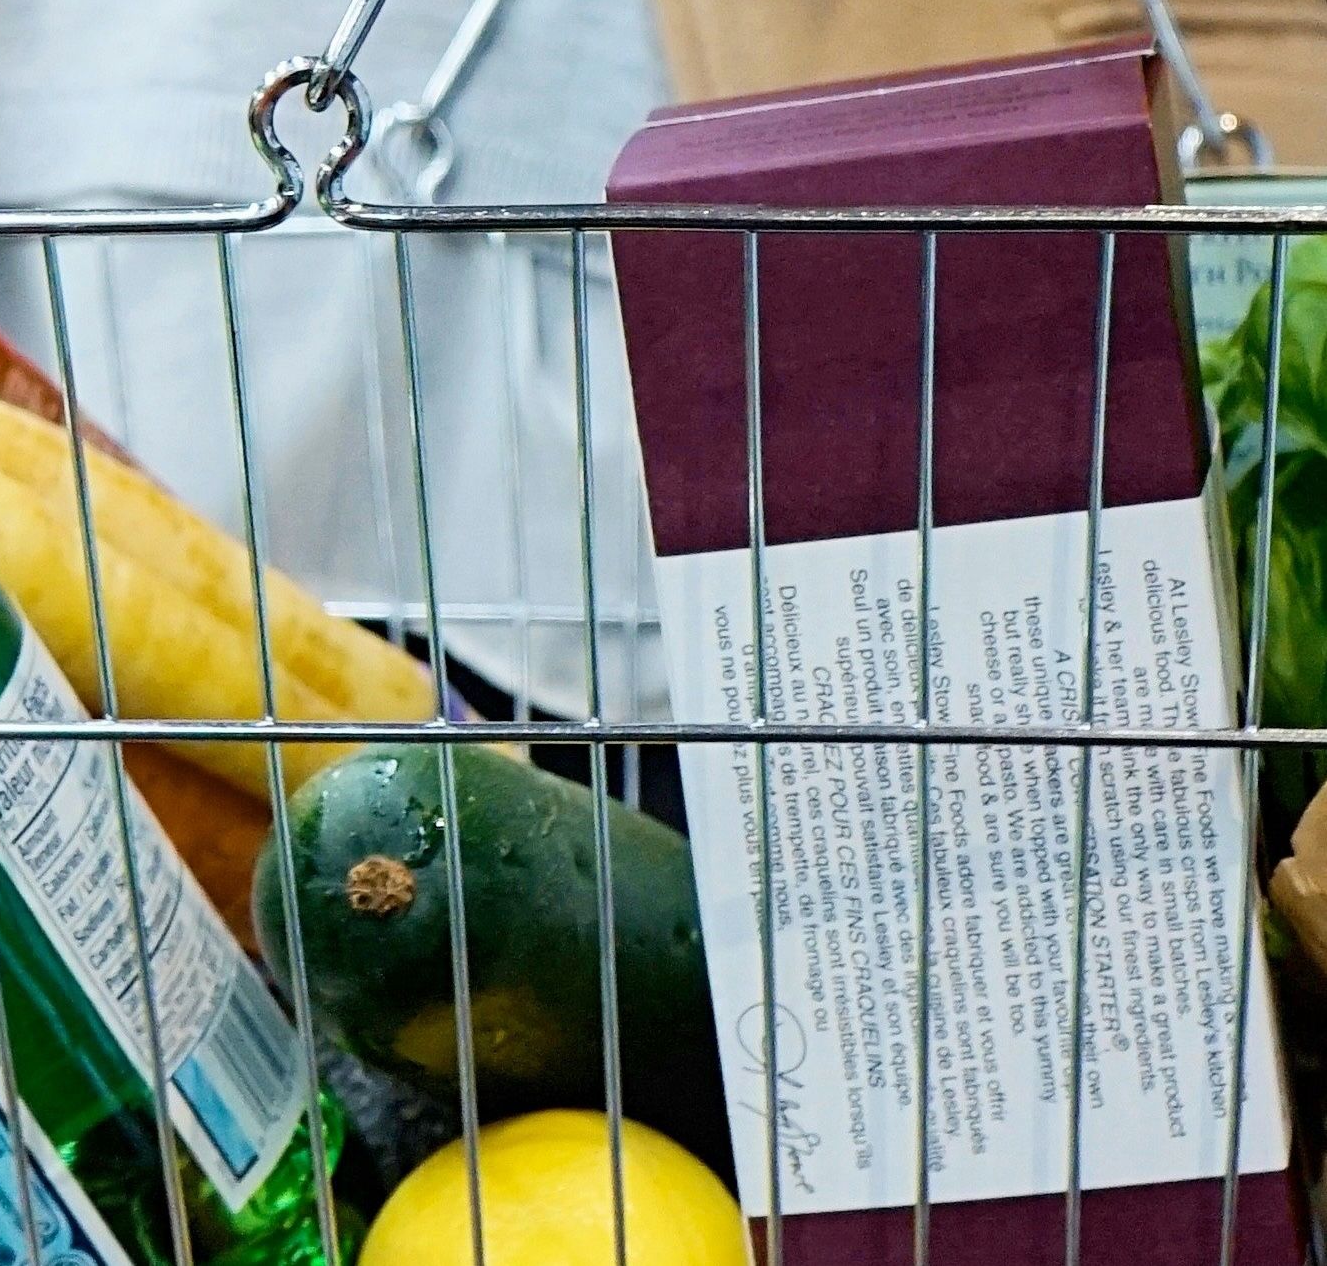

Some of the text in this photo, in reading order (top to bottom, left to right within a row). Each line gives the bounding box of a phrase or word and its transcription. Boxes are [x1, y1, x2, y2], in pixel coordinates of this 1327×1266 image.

[850, 568, 870, 611] Seul
[897, 578, 915, 603] de
[1169, 577, 1186, 597] At
[714, 606, 730, 649] vous
[779, 585, 805, 671] Délicieux
[857, 618, 870, 642] un
[876, 597, 892, 643] avec
[1004, 610, 1022, 639] but
[1024, 596, 1045, 649] these
[1105, 619, 1122, 632] &
[1168, 605, 1195, 667] Lesley
[721, 657, 735, 680] ne
[878, 648, 903, 694] soin,
[1004, 646, 1029, 696] really
[1056, 648, 1072, 663] A
[1108, 640, 1126, 670] her
[792, 678, 805, 702] au
[856, 648, 884, 714] produit
[933, 675, 954, 722] Stow
[1028, 656, 1055, 721] unique
[1113, 678, 1134, 726] team
[890, 700, 903, 723] en
[732, 764, 756, 804] plus
[781, 762, 798, 786] de
[847, 744, 875, 813] pouvait
[1024, 760, 1045, 811] when
[1100, 761, 1123, 830] scratch
[806, 786, 821, 819] ces
[949, 789, 970, 847] Foods
[982, 792, 998, 805] &
[1127, 786, 1145, 815] the
[1197, 789, 1219, 848] Foods
[743, 811, 759, 855] vous
[780, 792, 812, 888] trempette,
[876, 795, 905, 874] fabriqué
[985, 814, 999, 843] are
[1053, 814, 1068, 844] are
[1127, 822, 1151, 861] only
[1133, 666, 1193, 1017] are with care in small batches.
[1143, 559, 1230, 1119] delicious food. The fabulous crisps from Lesley's kitchen
[862, 819, 887, 904] satisfaire
[932, 831, 956, 909] fabuleux
[980, 610, 1056, 1104] cheese or We are addicted to this yummy
[990, 850, 1005, 891] sure
[1027, 818, 1054, 883] topped
[1105, 836, 1131, 887] using
[1205, 855, 1219, 882] we
[807, 824, 839, 922] craquelins
[957, 854, 979, 908] adore
[1054, 851, 1076, 899] great
[1133, 867, 1153, 905] way
[769, 879, 791, 931] nous,
[799, 894, 816, 917] de
[892, 879, 908, 923] avec
[991, 899, 1011, 932] you
[1041, 889, 1060, 926] with
[1117, 893, 1132, 923] our
[1143, 911, 1160, 928] to
[1210, 889, 1229, 928] love
[826, 928, 845, 968] sont
[828, 776, 884, 1089] POUR CES FINS CRAQUELINS
[870, 910, 897, 972] Lesley
[899, 929, 918, 963] des
[1001, 938, 1019, 967] will
[1042, 933, 1063, 974] your
[798, 924, 827, 1003] fromage
[939, 917, 970, 1014] craquelins
[961, 914, 990, 998] fabriquer
[1122, 930, 1143, 980] finest
[1147, 935, 1168, 986] make
[1211, 935, 1239, 1004] making
[884, 977, 900, 995] et
[1006, 974, 1023, 997] be
[1154, 994, 1166, 1004] a
[814, 1008, 828, 1031] ou
[832, 974, 860, 1079] irrésistibles
[887, 1001, 902, 1035] son
[977, 1004, 994, 1022] et
[937, 1045, 955, 1070] de
[957, 1020, 977, 1060] sont
[981, 1029, 997, 1072] vous
[1081, 1022, 1101, 1062] their
[1152, 1011, 1177, 1061] great
[987, 1079, 1007, 1121] offrir
[1087, 1070, 1103, 1108] own
[1159, 1065, 1187, 1138] product
[843, 1086, 872, 1169] lorsqu'ils
[959, 1067, 989, 1155] fabriqués
